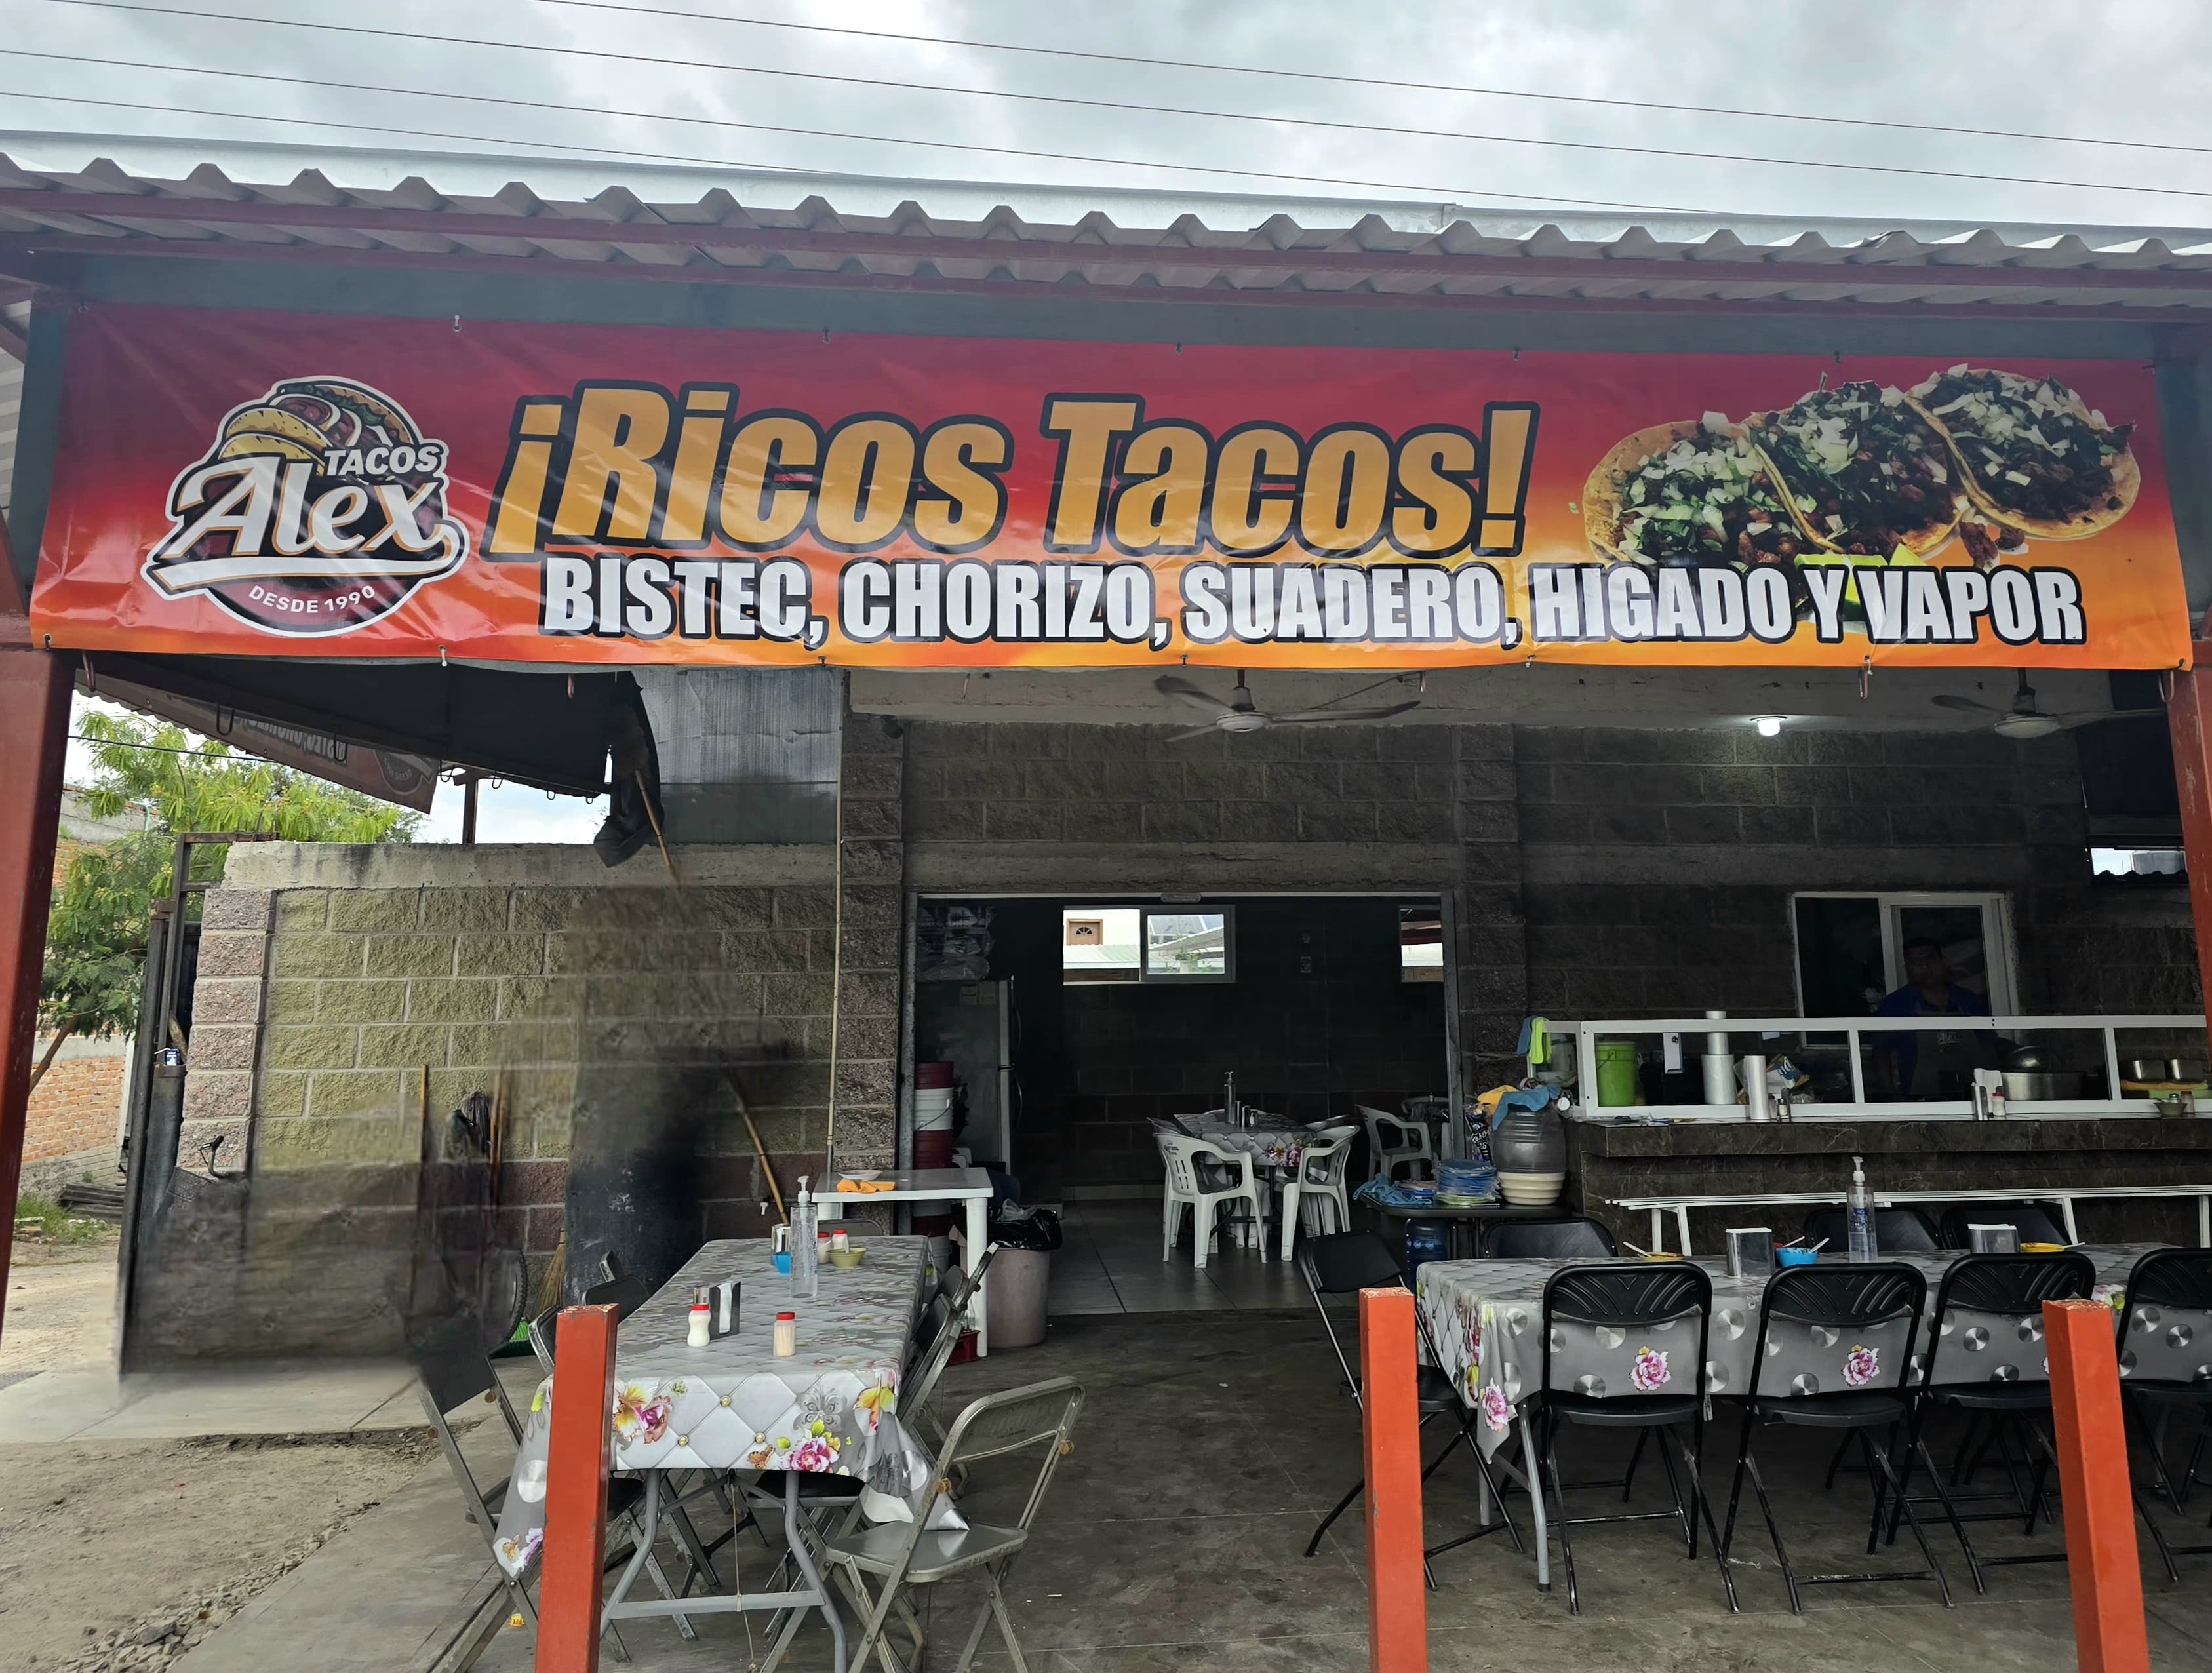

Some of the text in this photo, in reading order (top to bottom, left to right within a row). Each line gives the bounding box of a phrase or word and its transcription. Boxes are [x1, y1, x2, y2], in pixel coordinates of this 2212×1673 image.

[323, 445, 439, 476] TACOS
[486, 385, 1533, 555] ¡Ricos Tacos!
[161, 456, 443, 558] Alex
[248, 584, 376, 614] DESDE 1990
[543, 557, 2082, 648] BISTEC, CHORIZO, SUADERO, HIGADO Y VAPOR
